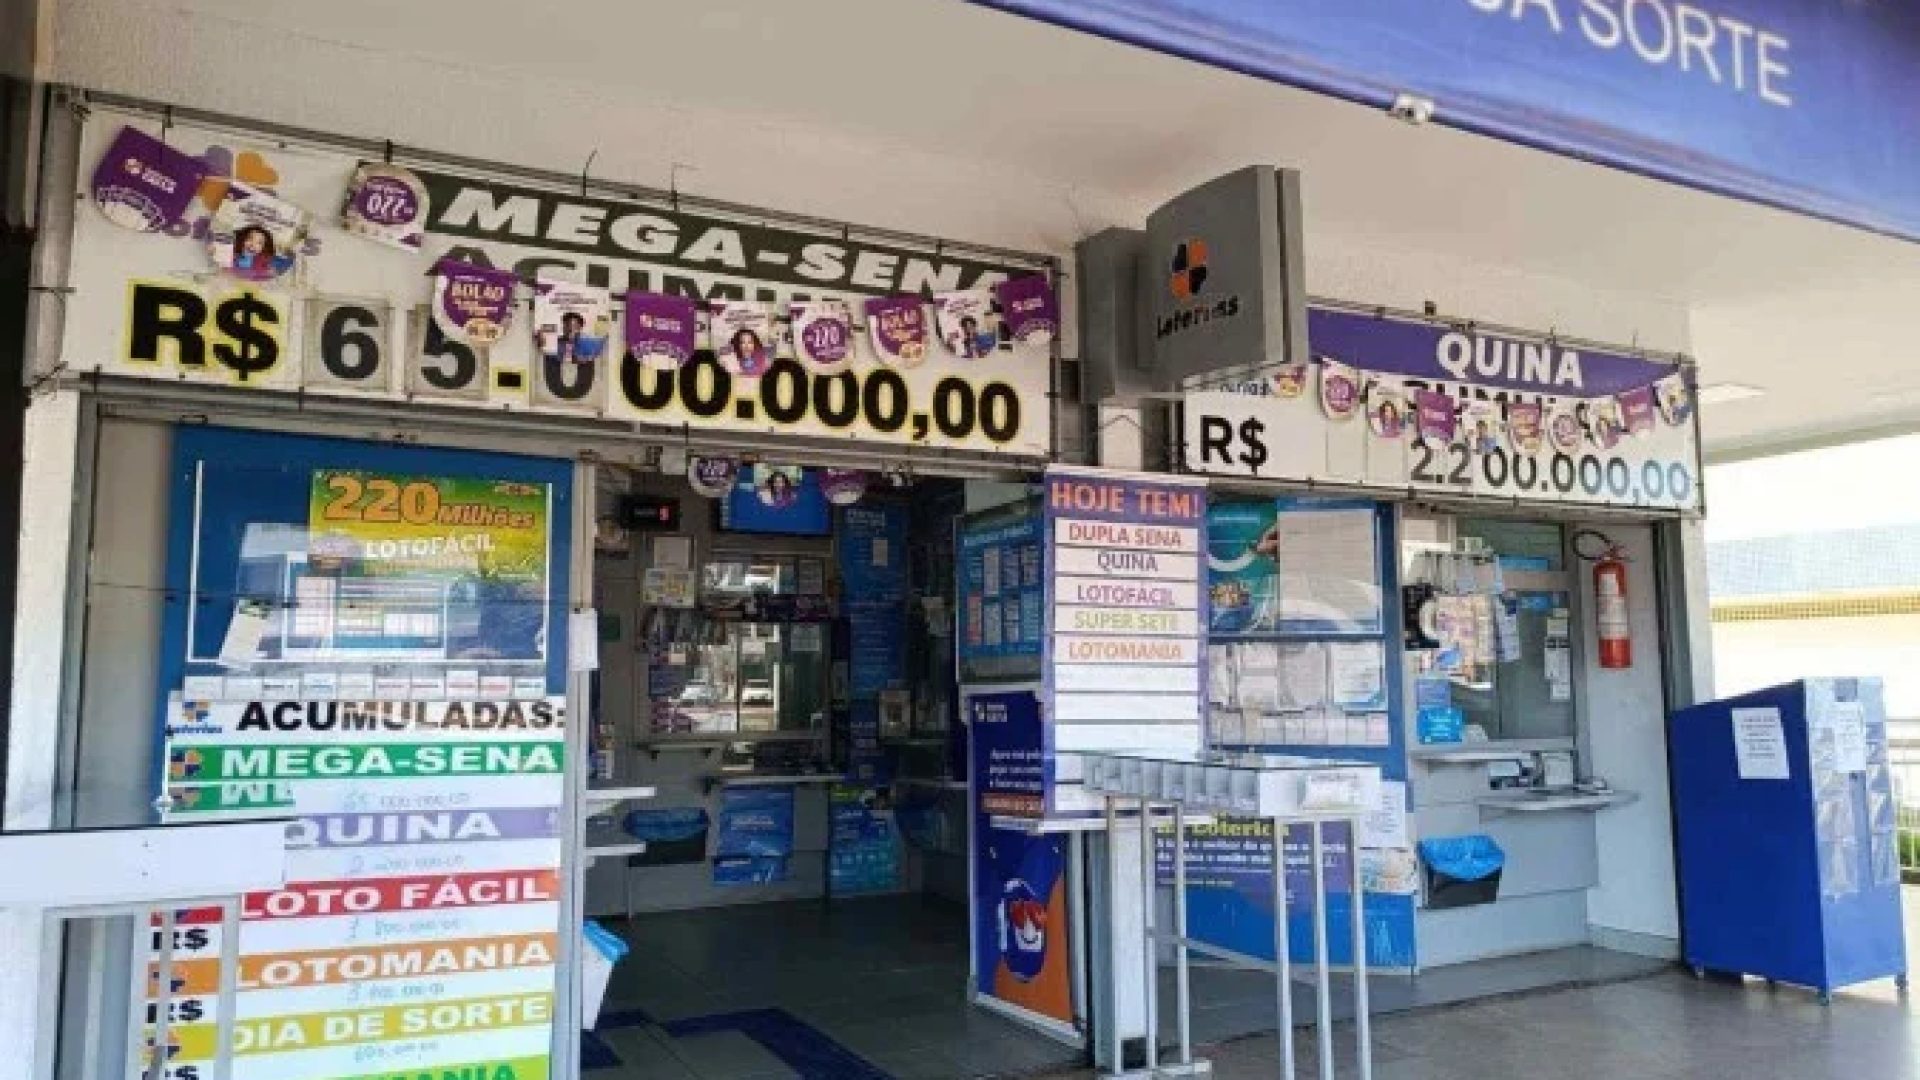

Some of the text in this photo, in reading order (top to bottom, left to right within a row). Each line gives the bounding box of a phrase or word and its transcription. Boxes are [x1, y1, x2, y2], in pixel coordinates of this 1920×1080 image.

[1578, 0, 1793, 107] SORTE
[129, 284, 280, 381] R$
[1436, 332, 1583, 388] QUINA
[1200, 414, 1268, 475] R$
[324, 474, 440, 527] 220
[1051, 482, 1126, 513] HOJE
[1135, 487, 1201, 519] TEM!
[365, 534, 496, 561] LOTOFÁCIL
[1068, 522, 1182, 547] DUPLA SENA
[1097, 552, 1159, 572] QUINA
[1074, 610, 1133, 629] SUPER
[1068, 641, 1183, 660] LOTOMANIA
[235, 701, 568, 731] ACUMULADAS:
[221, 746, 560, 777] MEGA-SENA
[284, 811, 501, 847] QUINA
[241, 874, 550, 917] LOTO FÁCIL
[236, 940, 551, 989] LOTOMANIA
[324, 1013, 385, 1041] DE
[400, 997, 548, 1033] SORTE
